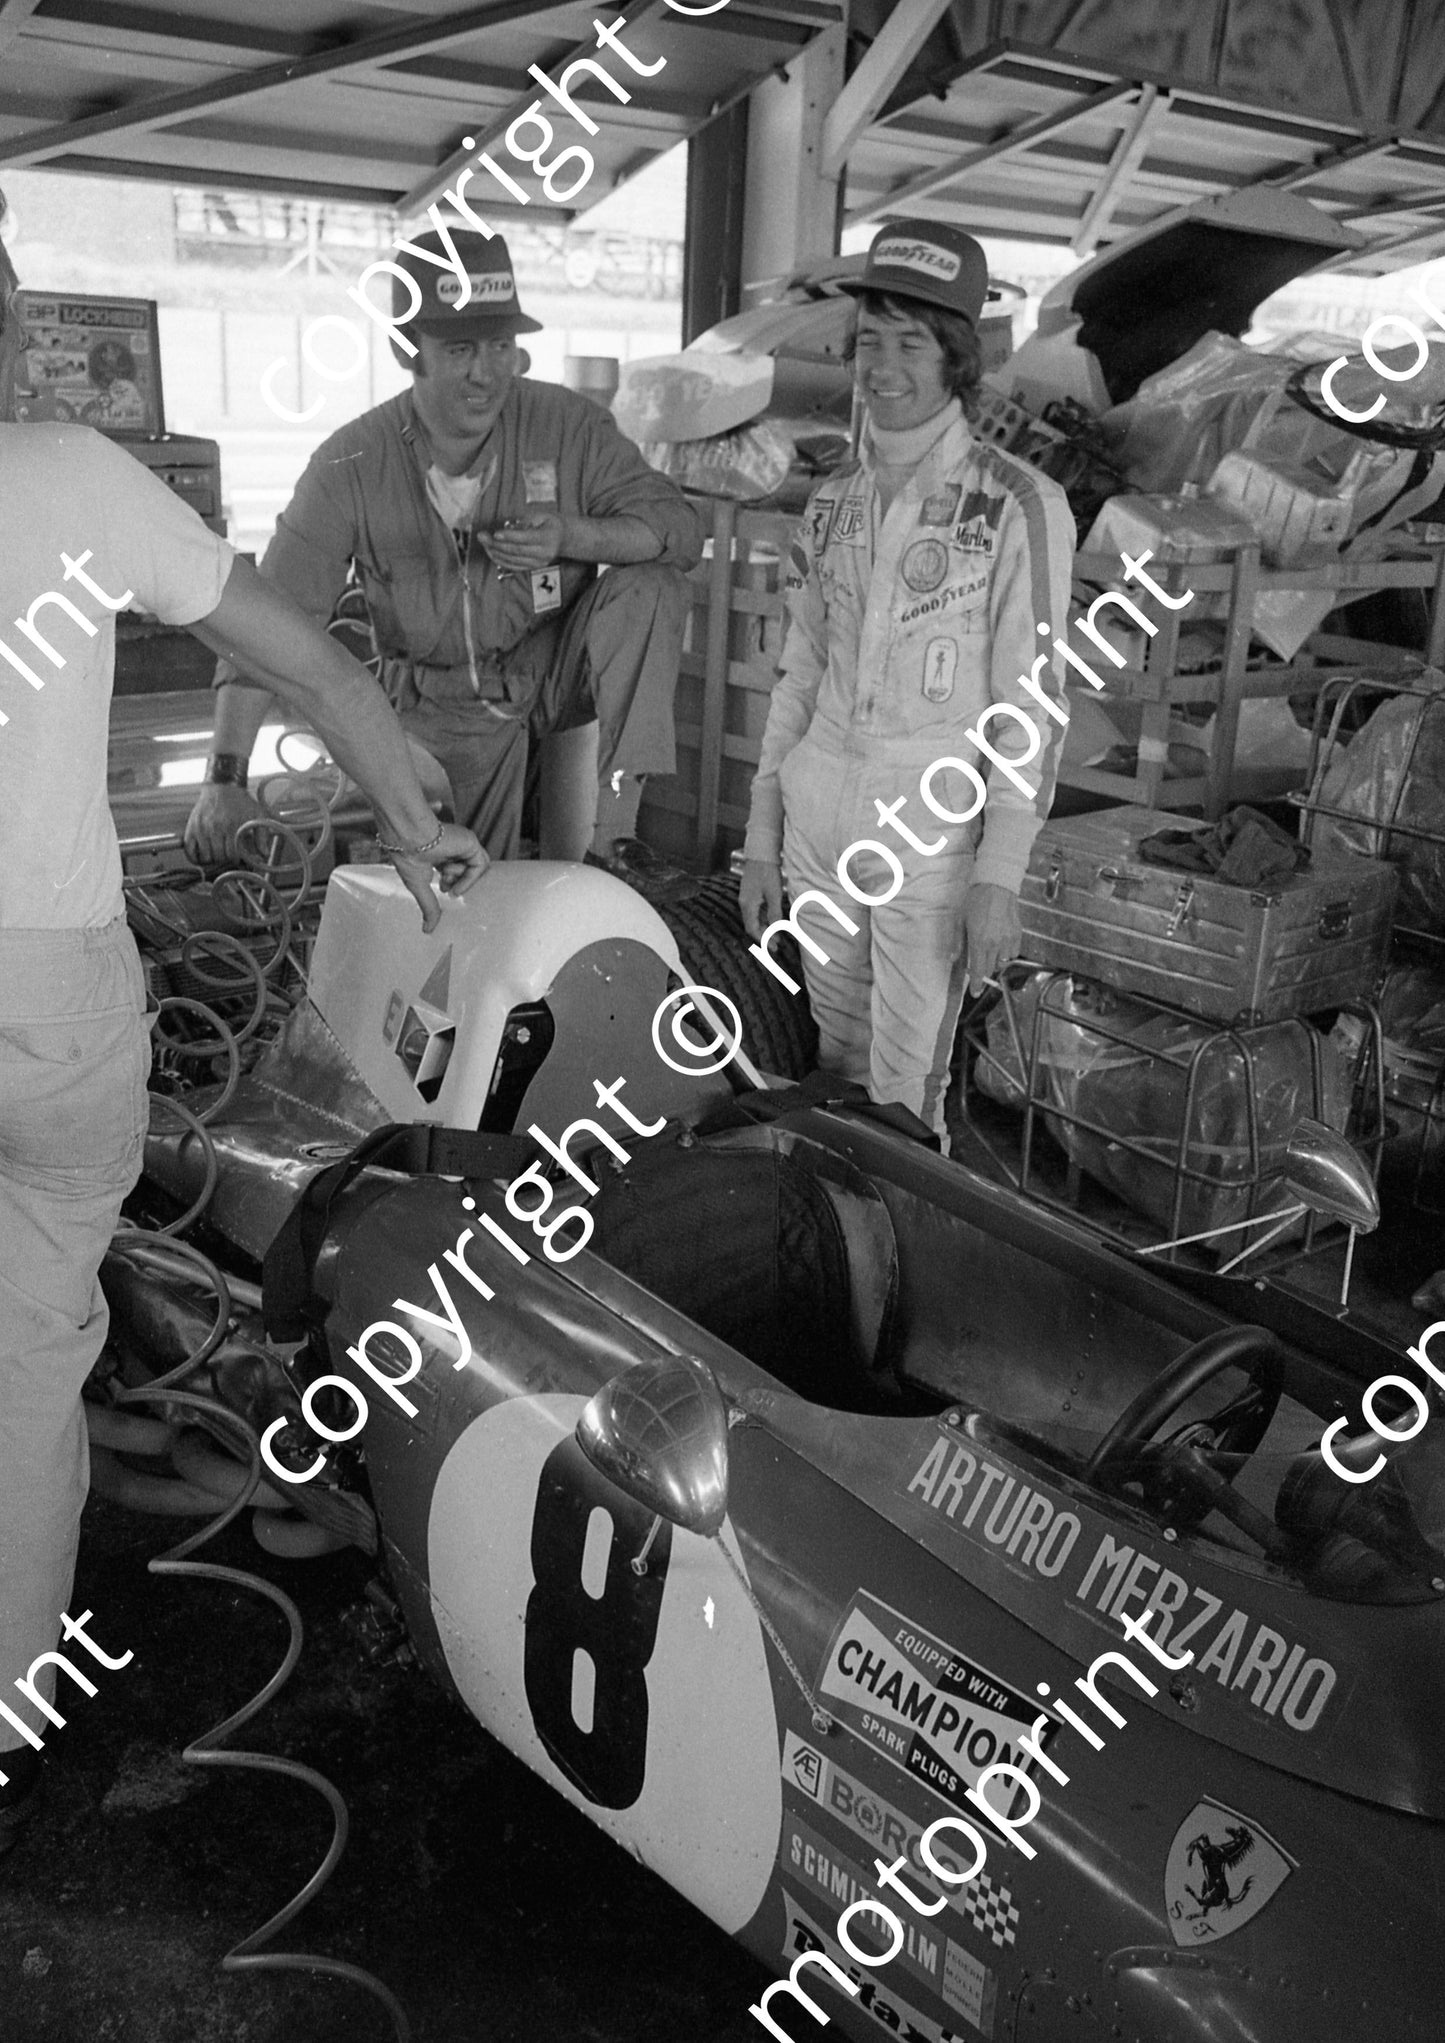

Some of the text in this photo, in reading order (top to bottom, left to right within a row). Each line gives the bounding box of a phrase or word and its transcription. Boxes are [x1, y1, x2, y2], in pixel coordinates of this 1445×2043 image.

[440, 277, 512, 295] GODYEAR
[901, 577, 986, 622] GOODYEAR
[524, 1430, 673, 1811] 8
[907, 1435, 1337, 1732] ARTURO MERZARIO
[894, 1628, 1009, 1710] EQUIPPED WITH
[837, 1639, 1025, 1789] CHAMPION
[861, 1713, 958, 1793] SPARK PLUGS
